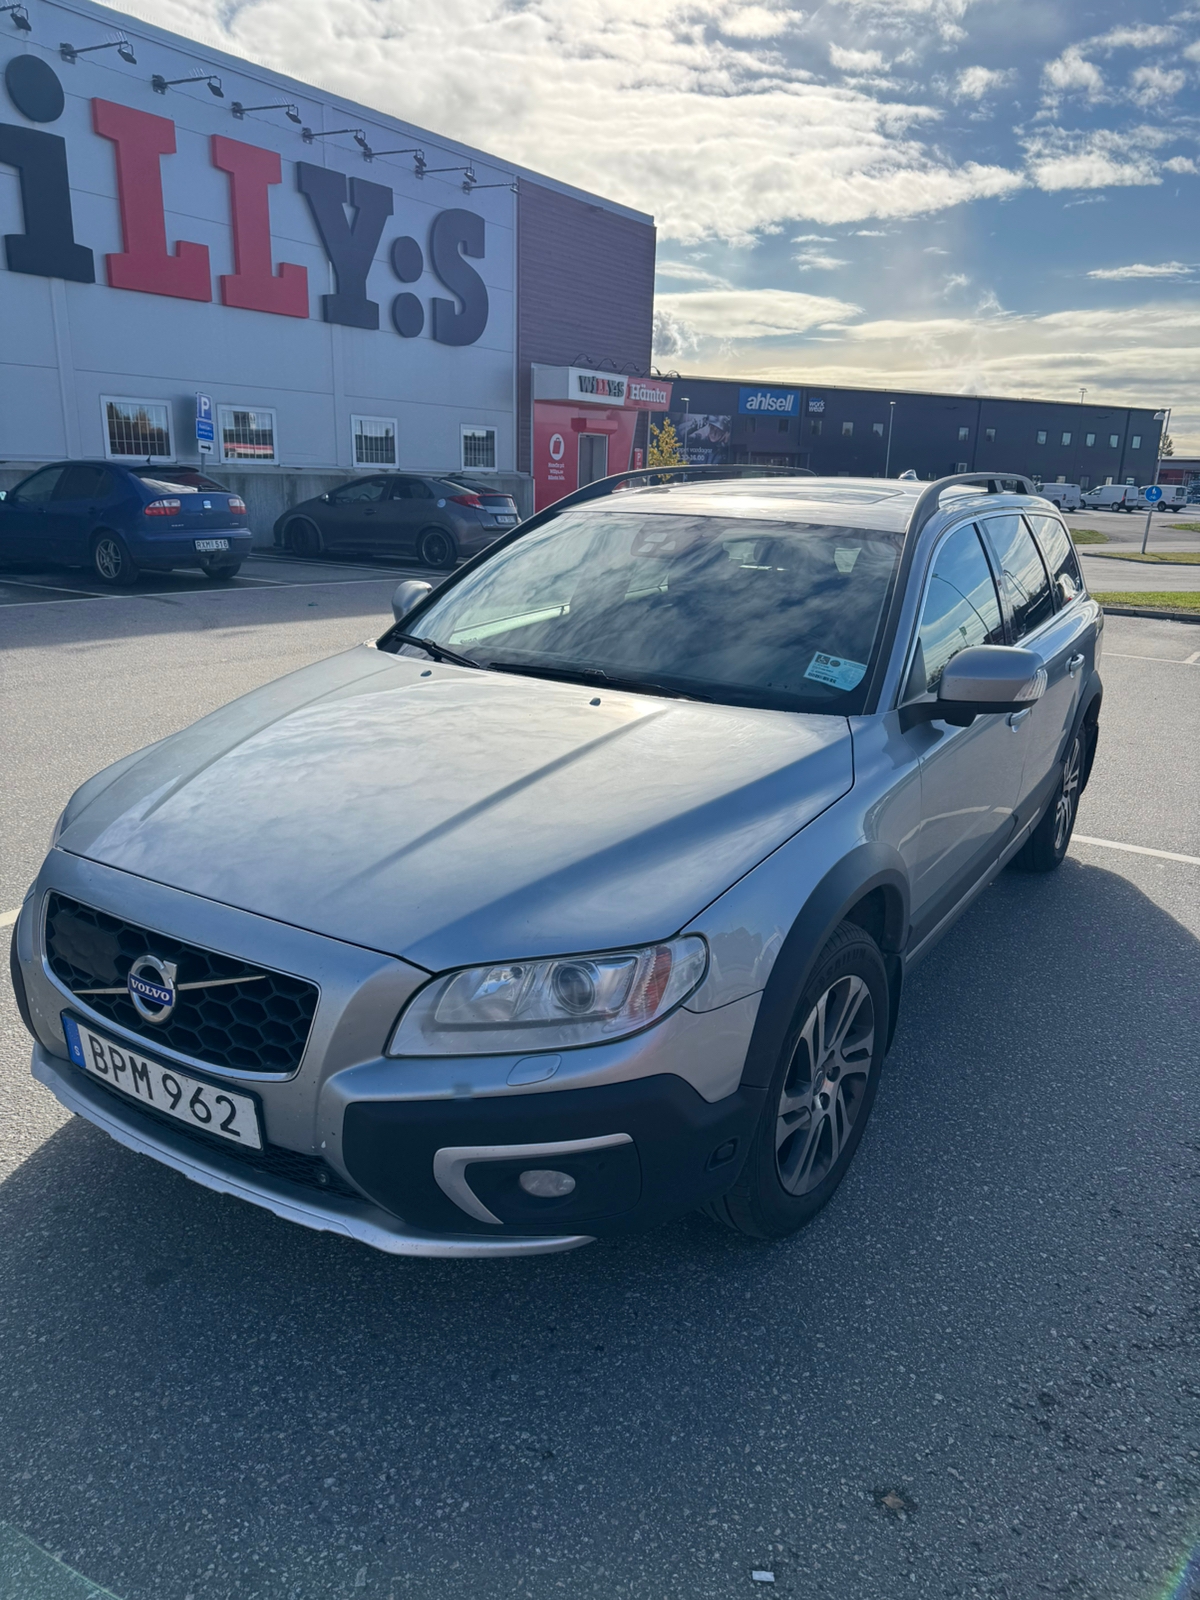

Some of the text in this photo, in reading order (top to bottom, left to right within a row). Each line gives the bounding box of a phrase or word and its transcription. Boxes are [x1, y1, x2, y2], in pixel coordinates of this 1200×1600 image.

[0, 54, 489, 347] iLLY:S
[630, 384, 666, 403] Hämta
[746, 393, 794, 411] ahlsell
[201, 397, 210, 417] P
[131, 978, 170, 1002] VOLVO
[74, 1045, 80, 1056] S
[87, 1033, 241, 1138] BPM 962
